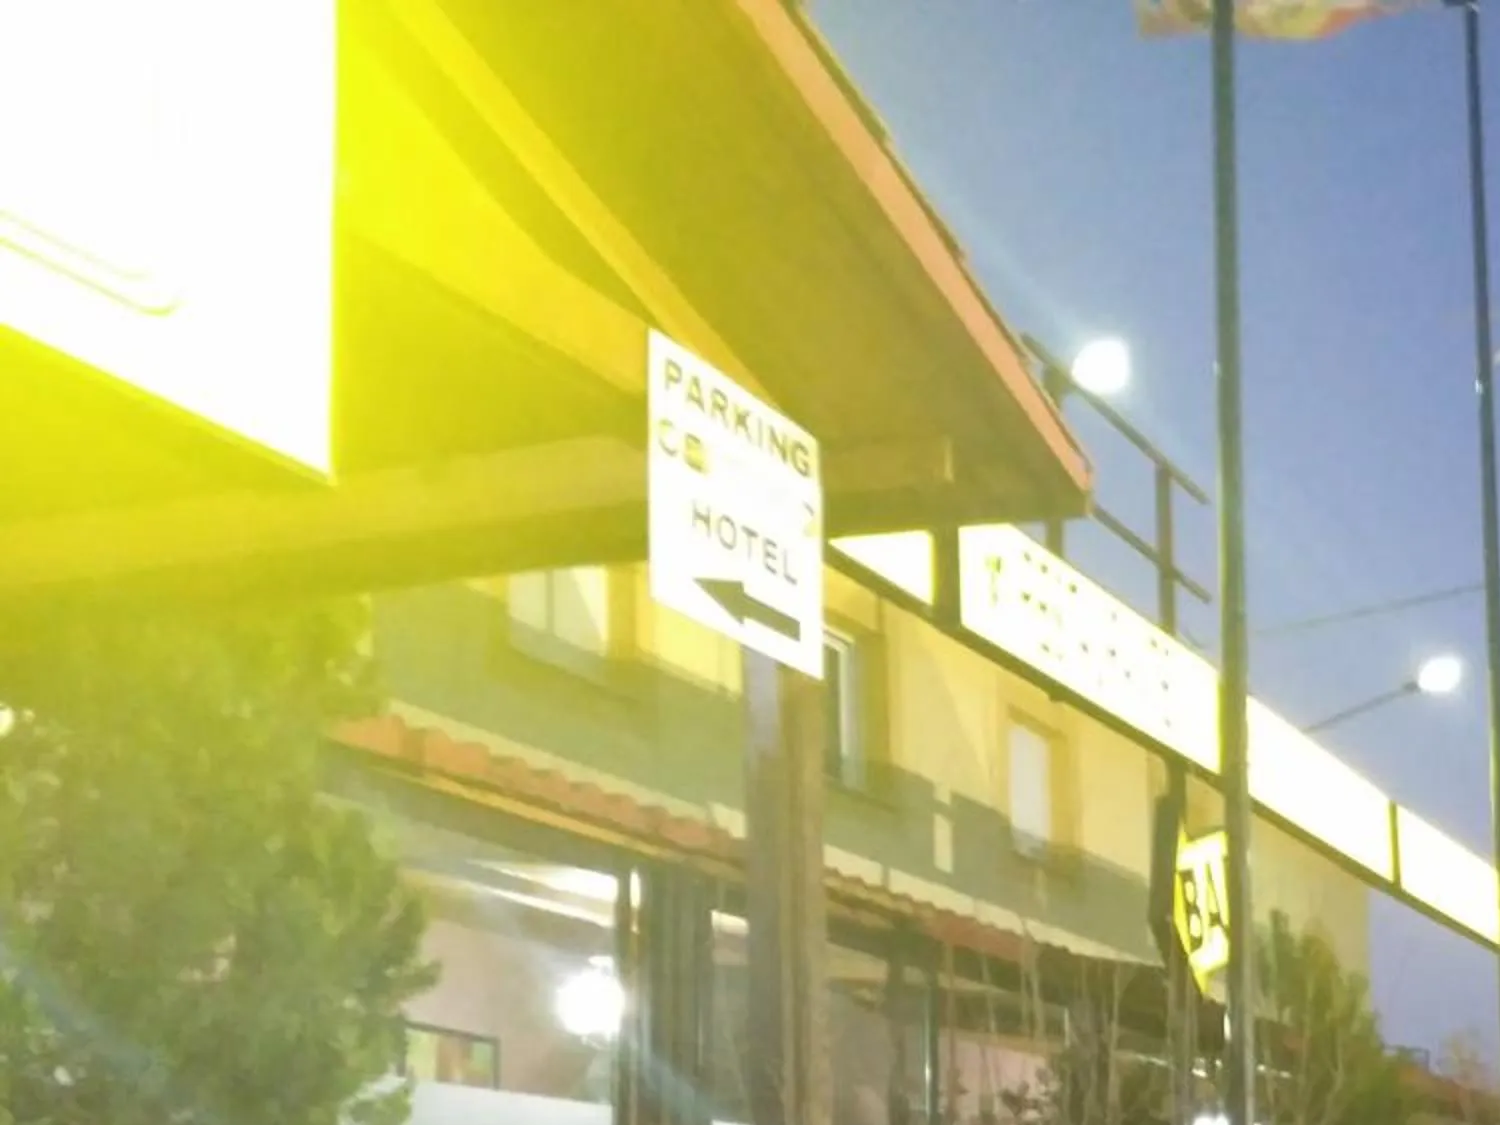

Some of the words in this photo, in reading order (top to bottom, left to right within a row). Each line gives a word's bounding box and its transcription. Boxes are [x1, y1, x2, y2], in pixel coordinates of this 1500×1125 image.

[662, 356, 813, 478] PARKING
[691, 499, 799, 586] HOTEL
[1179, 855, 1231, 953] BA
